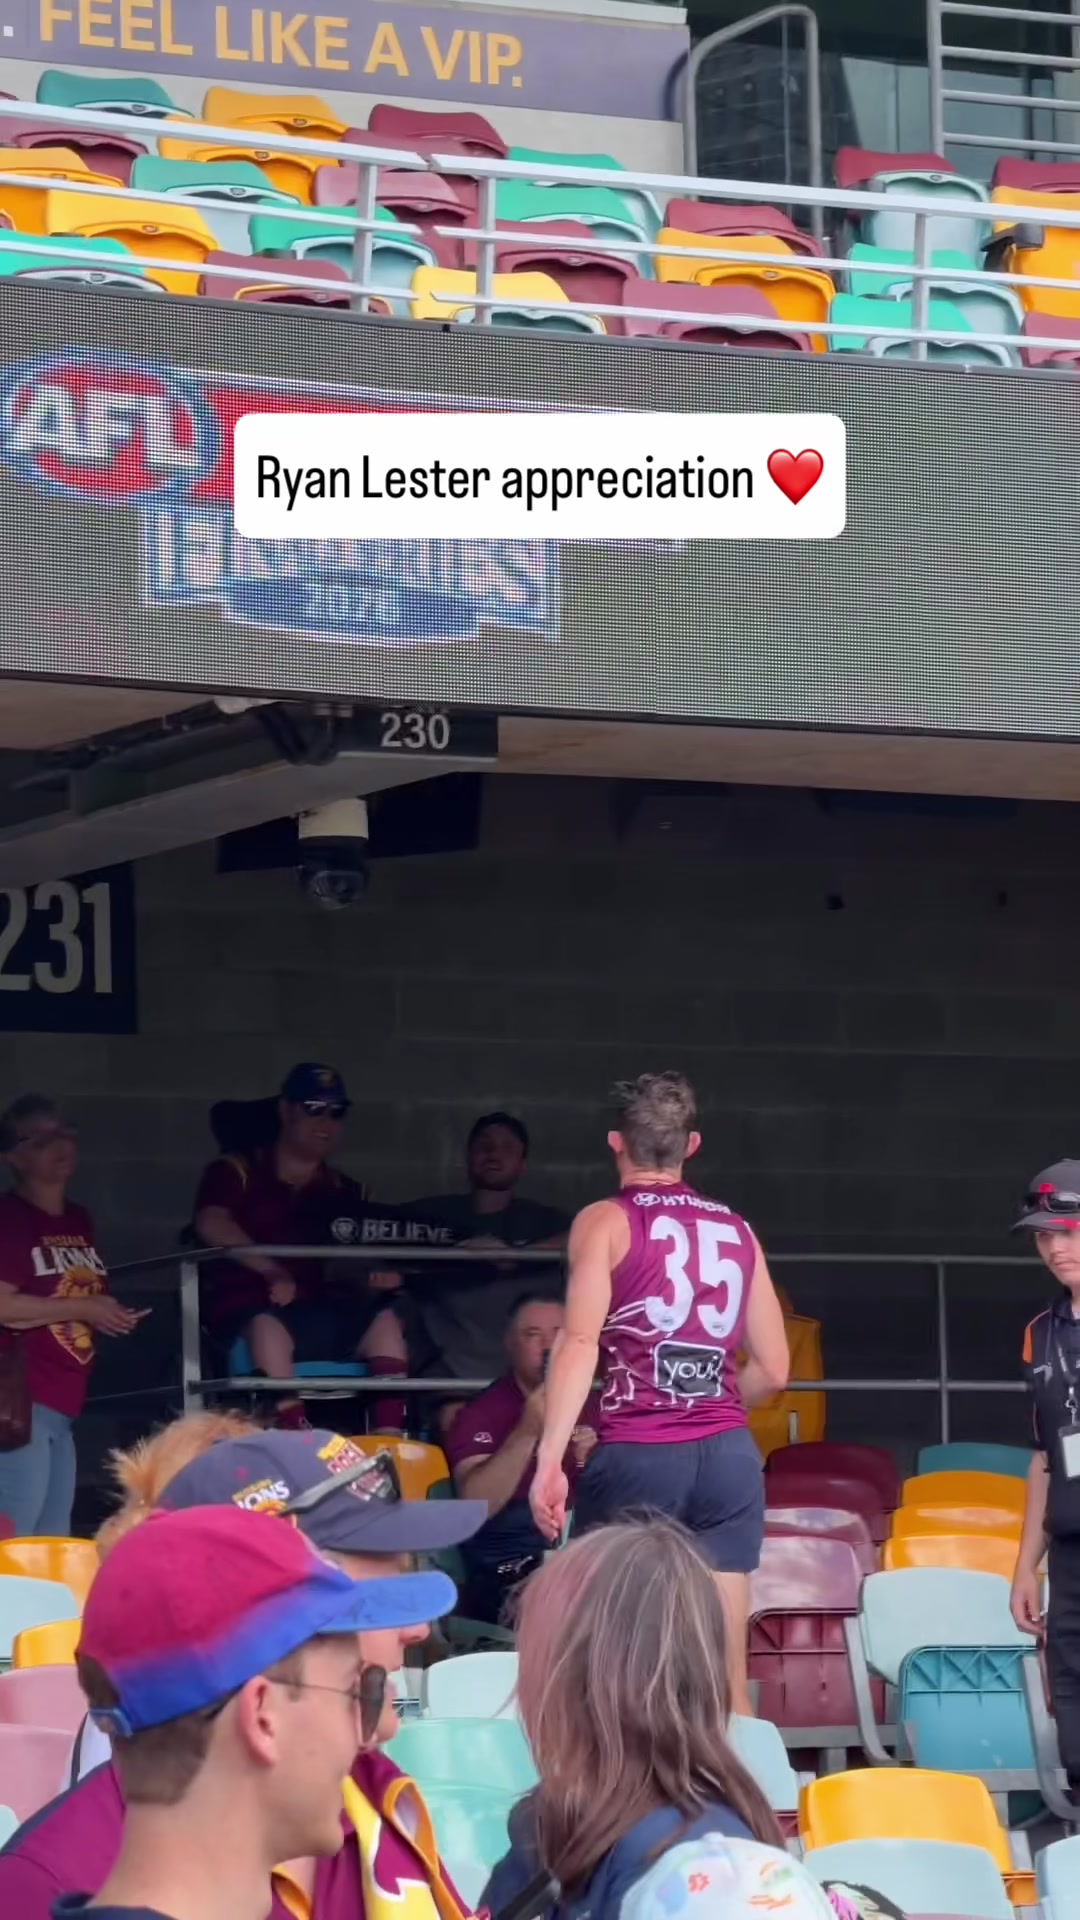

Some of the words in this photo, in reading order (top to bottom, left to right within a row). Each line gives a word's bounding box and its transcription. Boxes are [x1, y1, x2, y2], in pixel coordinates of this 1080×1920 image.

[40, 0, 193, 55] FEEL
[215, 6, 349, 71] LIKE
[363, 22, 409, 76] A
[420, 26, 523, 88] VIP.
[6, 384, 200, 466] AFL
[381, 712, 450, 750] 230
[0, 880, 112, 994] 231
[362, 1219, 454, 1243] BELIEVE
[645, 1215, 743, 1339] 35
